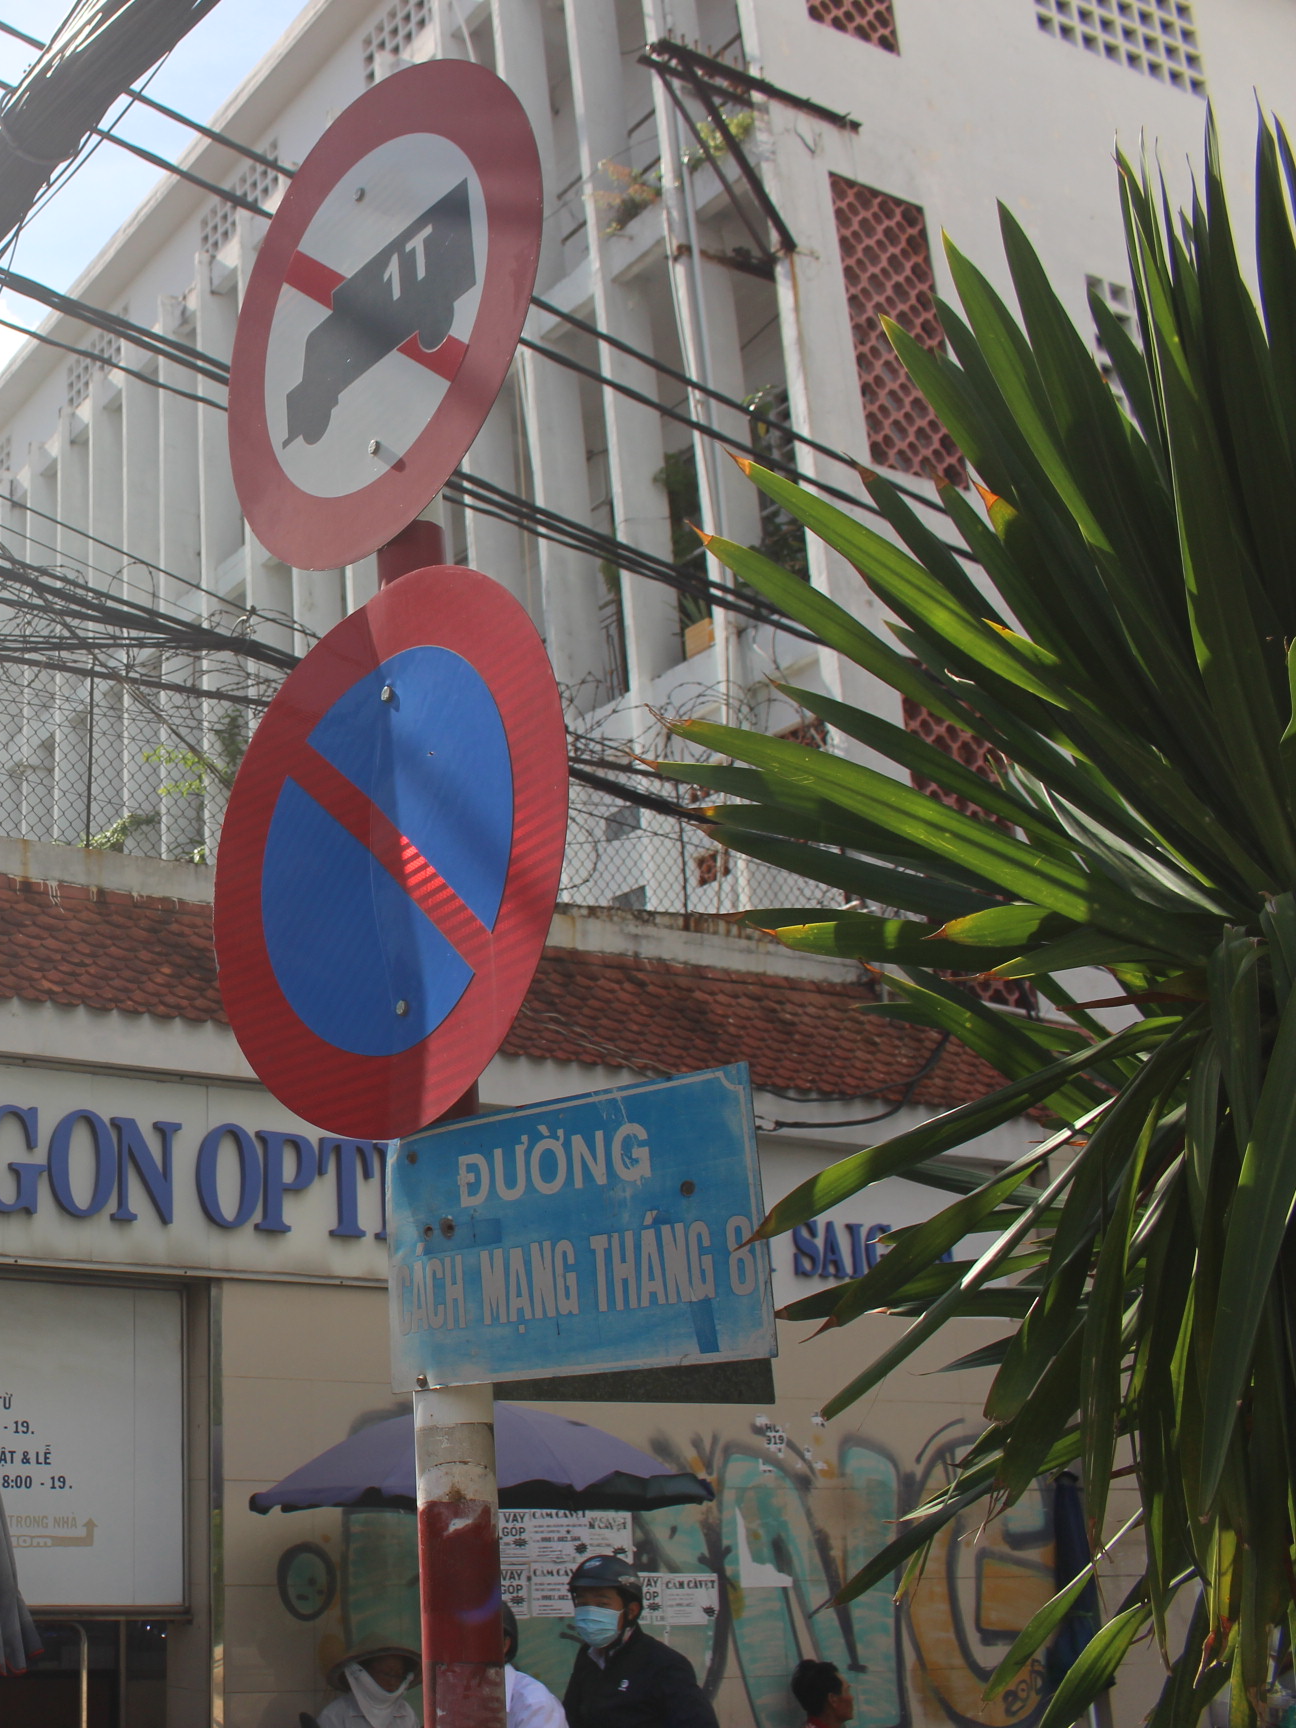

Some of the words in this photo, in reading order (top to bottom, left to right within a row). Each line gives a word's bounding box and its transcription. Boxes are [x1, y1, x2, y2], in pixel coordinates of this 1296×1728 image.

[383, 223, 432, 301] 1T
[456, 1122, 652, 1208] ĐƯỜNG
[394, 1242, 467, 1337] CÁCH
[479, 1239, 579, 1334] MẠNG
[589, 1210, 716, 1313] THÁNG
[725, 1215, 757, 1296] 8
[21, 1451, 31, 1465] &
[35, 1444, 52, 1465] LỄ
[2, 1474, 32, 1490] 8:00
[7, 1514, 49, 1529] TRONG
[53, 1512, 78, 1530] NHÀ
[503, 1513, 526, 1524] VAY
[501, 1524, 526, 1537] GÓP
